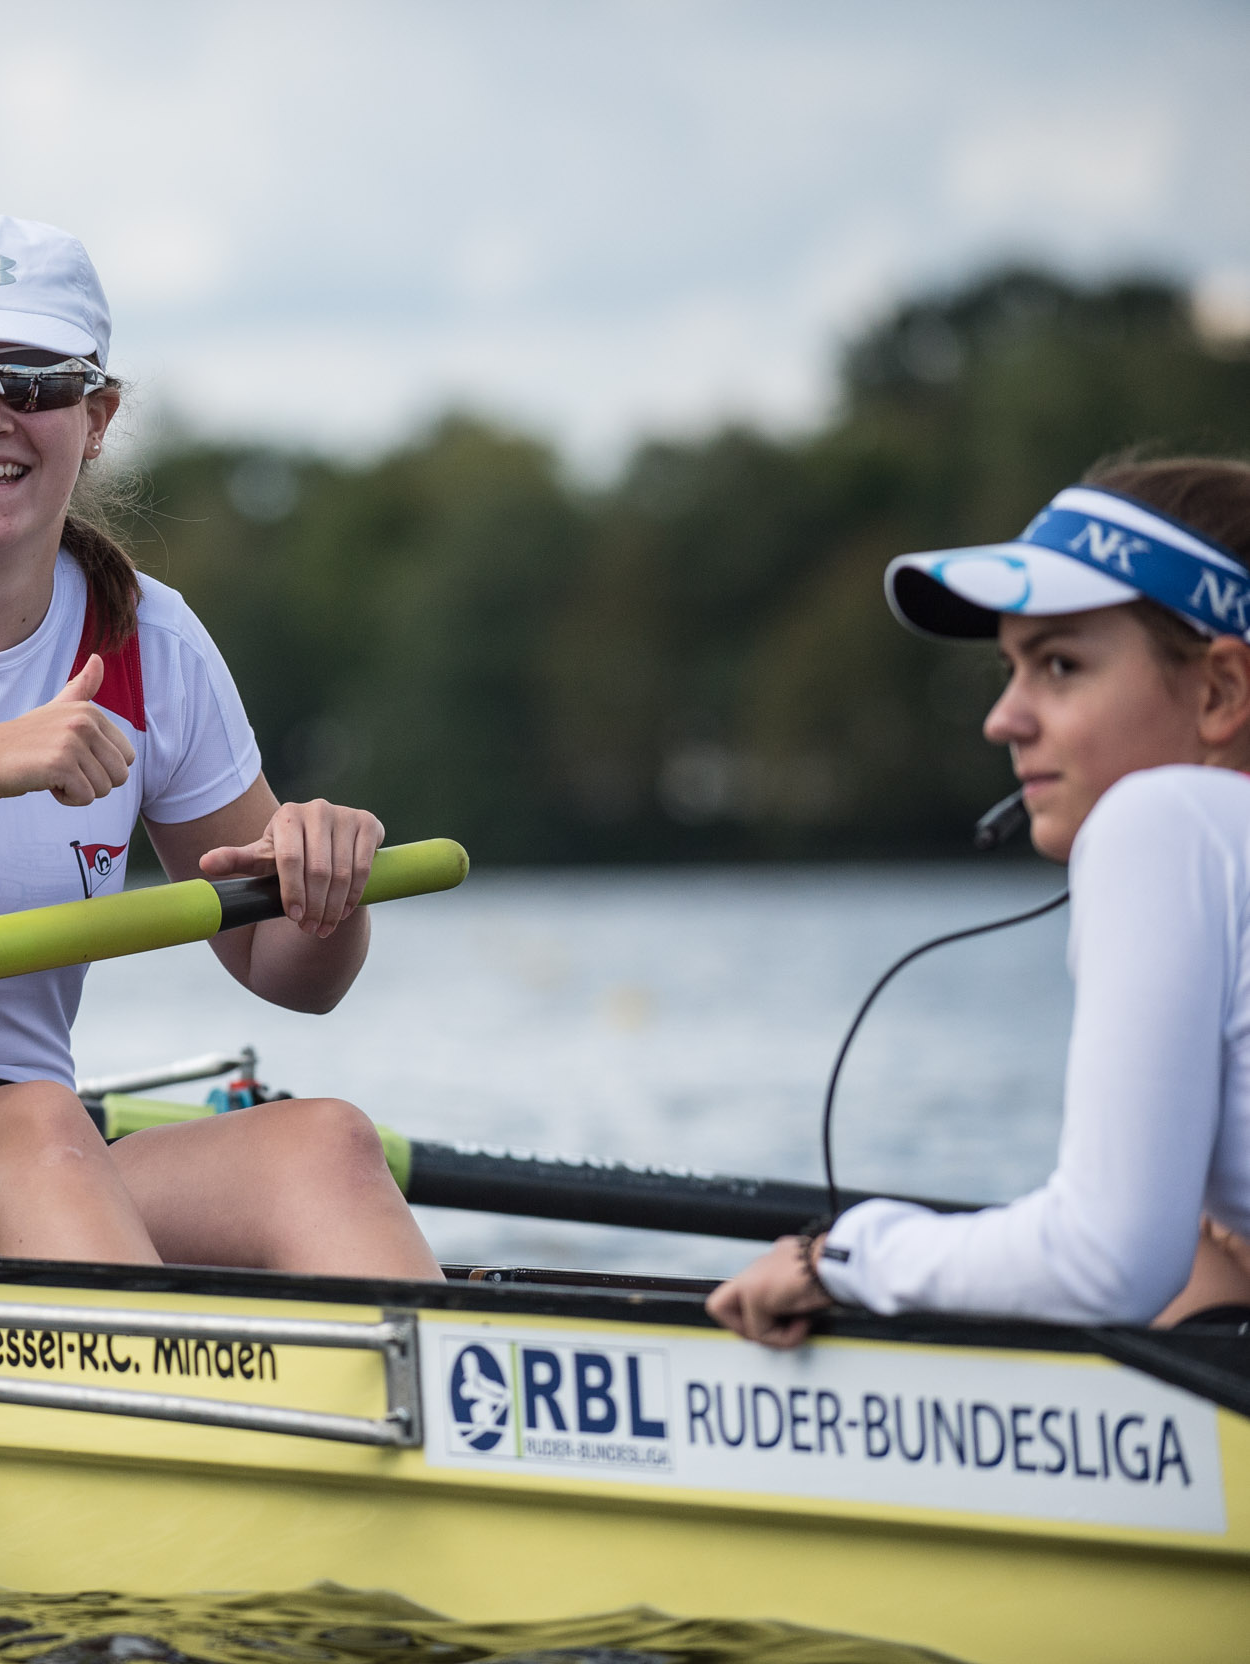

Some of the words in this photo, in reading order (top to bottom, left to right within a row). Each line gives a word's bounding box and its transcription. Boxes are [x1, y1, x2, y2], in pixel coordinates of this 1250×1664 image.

[153, 1338, 277, 1381] Minden
[522, 1349, 667, 1439] RBL
[686, 1381, 1193, 1488] RUDER-BUNDESLIGA
